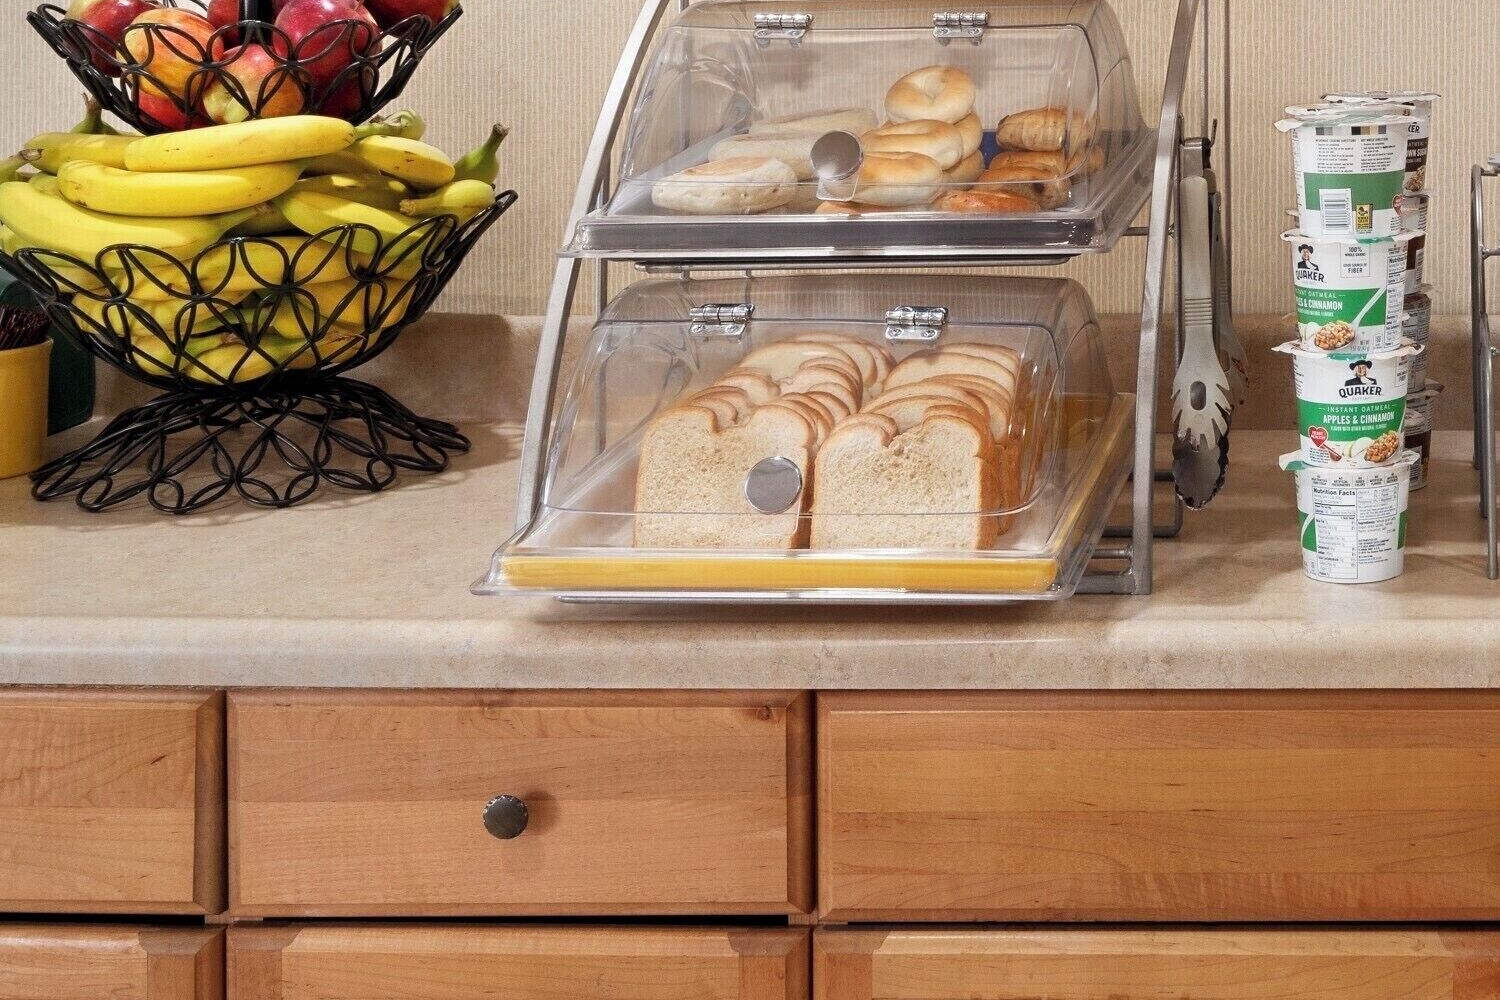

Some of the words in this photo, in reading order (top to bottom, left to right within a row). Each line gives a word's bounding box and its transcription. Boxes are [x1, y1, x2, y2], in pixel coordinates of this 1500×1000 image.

[1295, 270, 1325, 283] QUAKER
[1308, 300, 1343, 311] CINNAMON
[1338, 386, 1382, 399] QUAKER
[1361, 404, 1391, 412] OATMEAL
[1323, 414, 1351, 425] APPLES
[1352, 415, 1359, 425] &
[1360, 411, 1395, 424] CINNAMON
[1313, 488, 1338, 496] Nutrition
